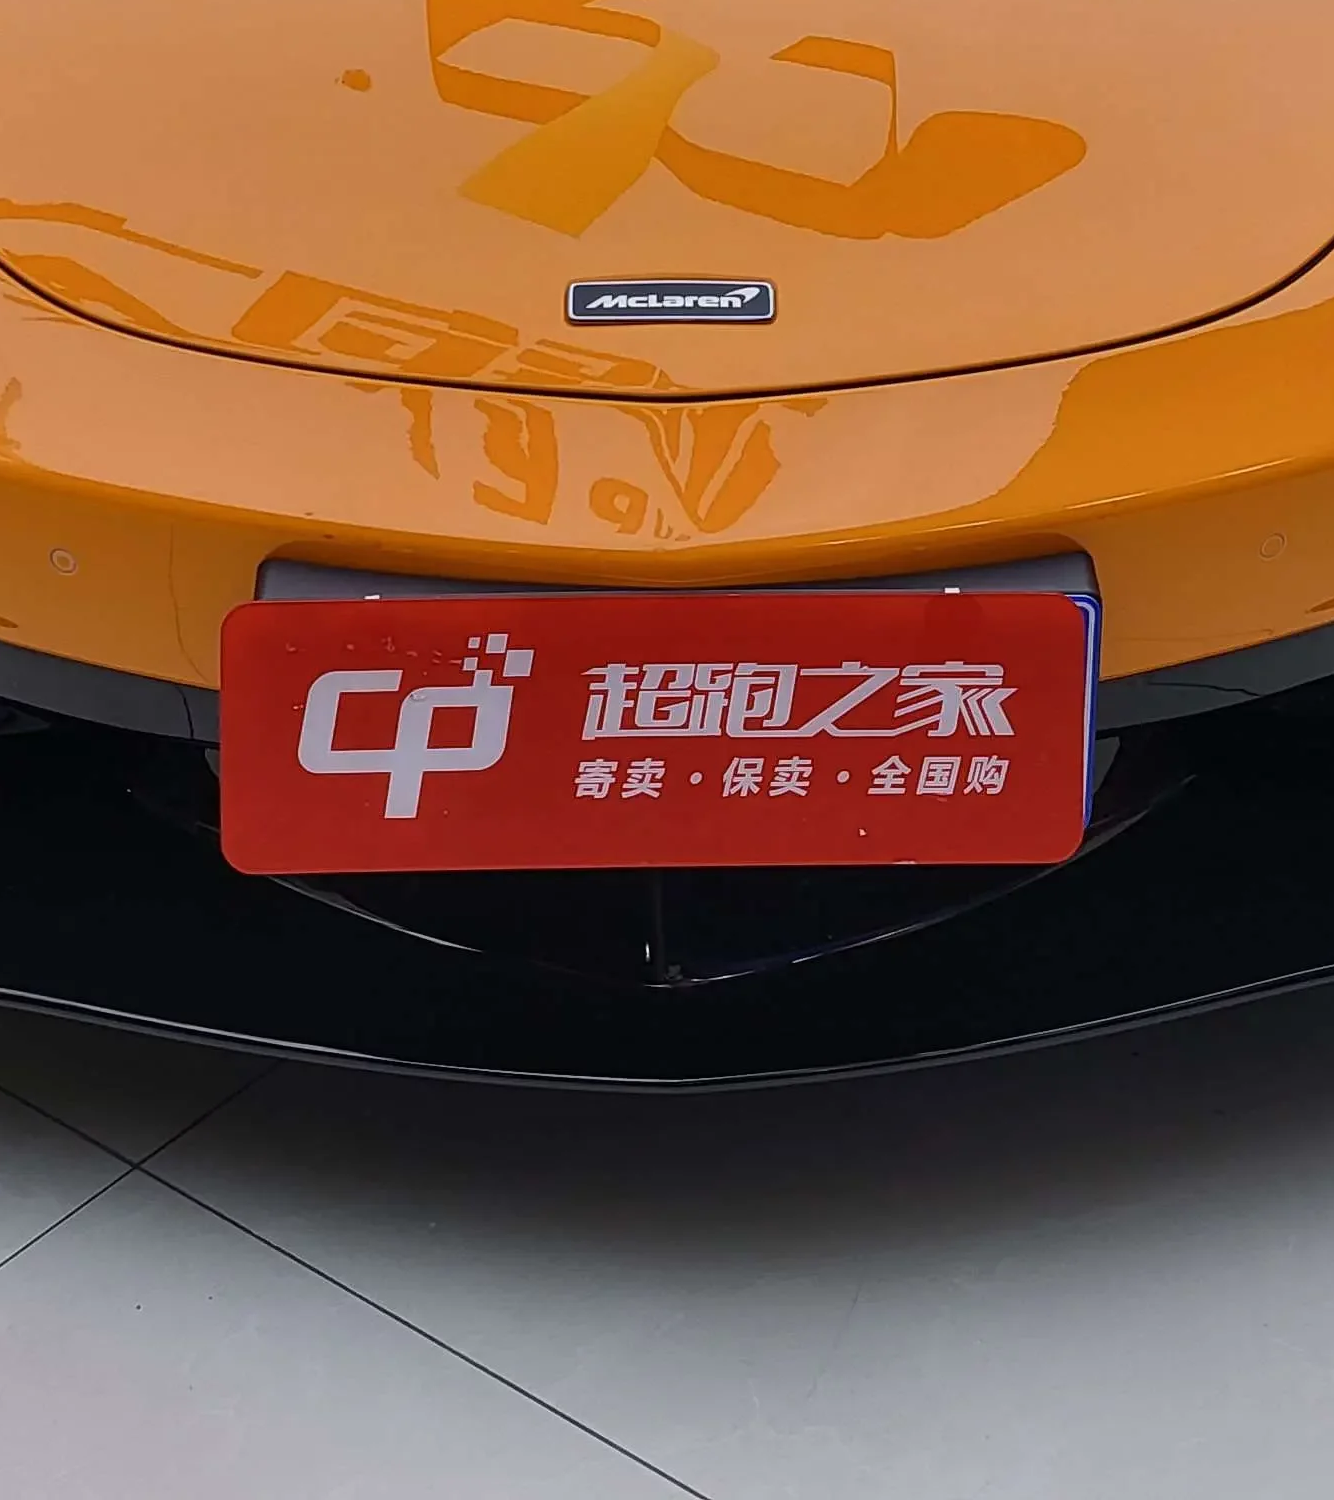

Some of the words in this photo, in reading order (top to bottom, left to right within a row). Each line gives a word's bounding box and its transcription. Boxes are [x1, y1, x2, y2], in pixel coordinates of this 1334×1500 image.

[585, 294, 742, 309] McLaren
[580, 661, 1017, 740] 超跑之家
